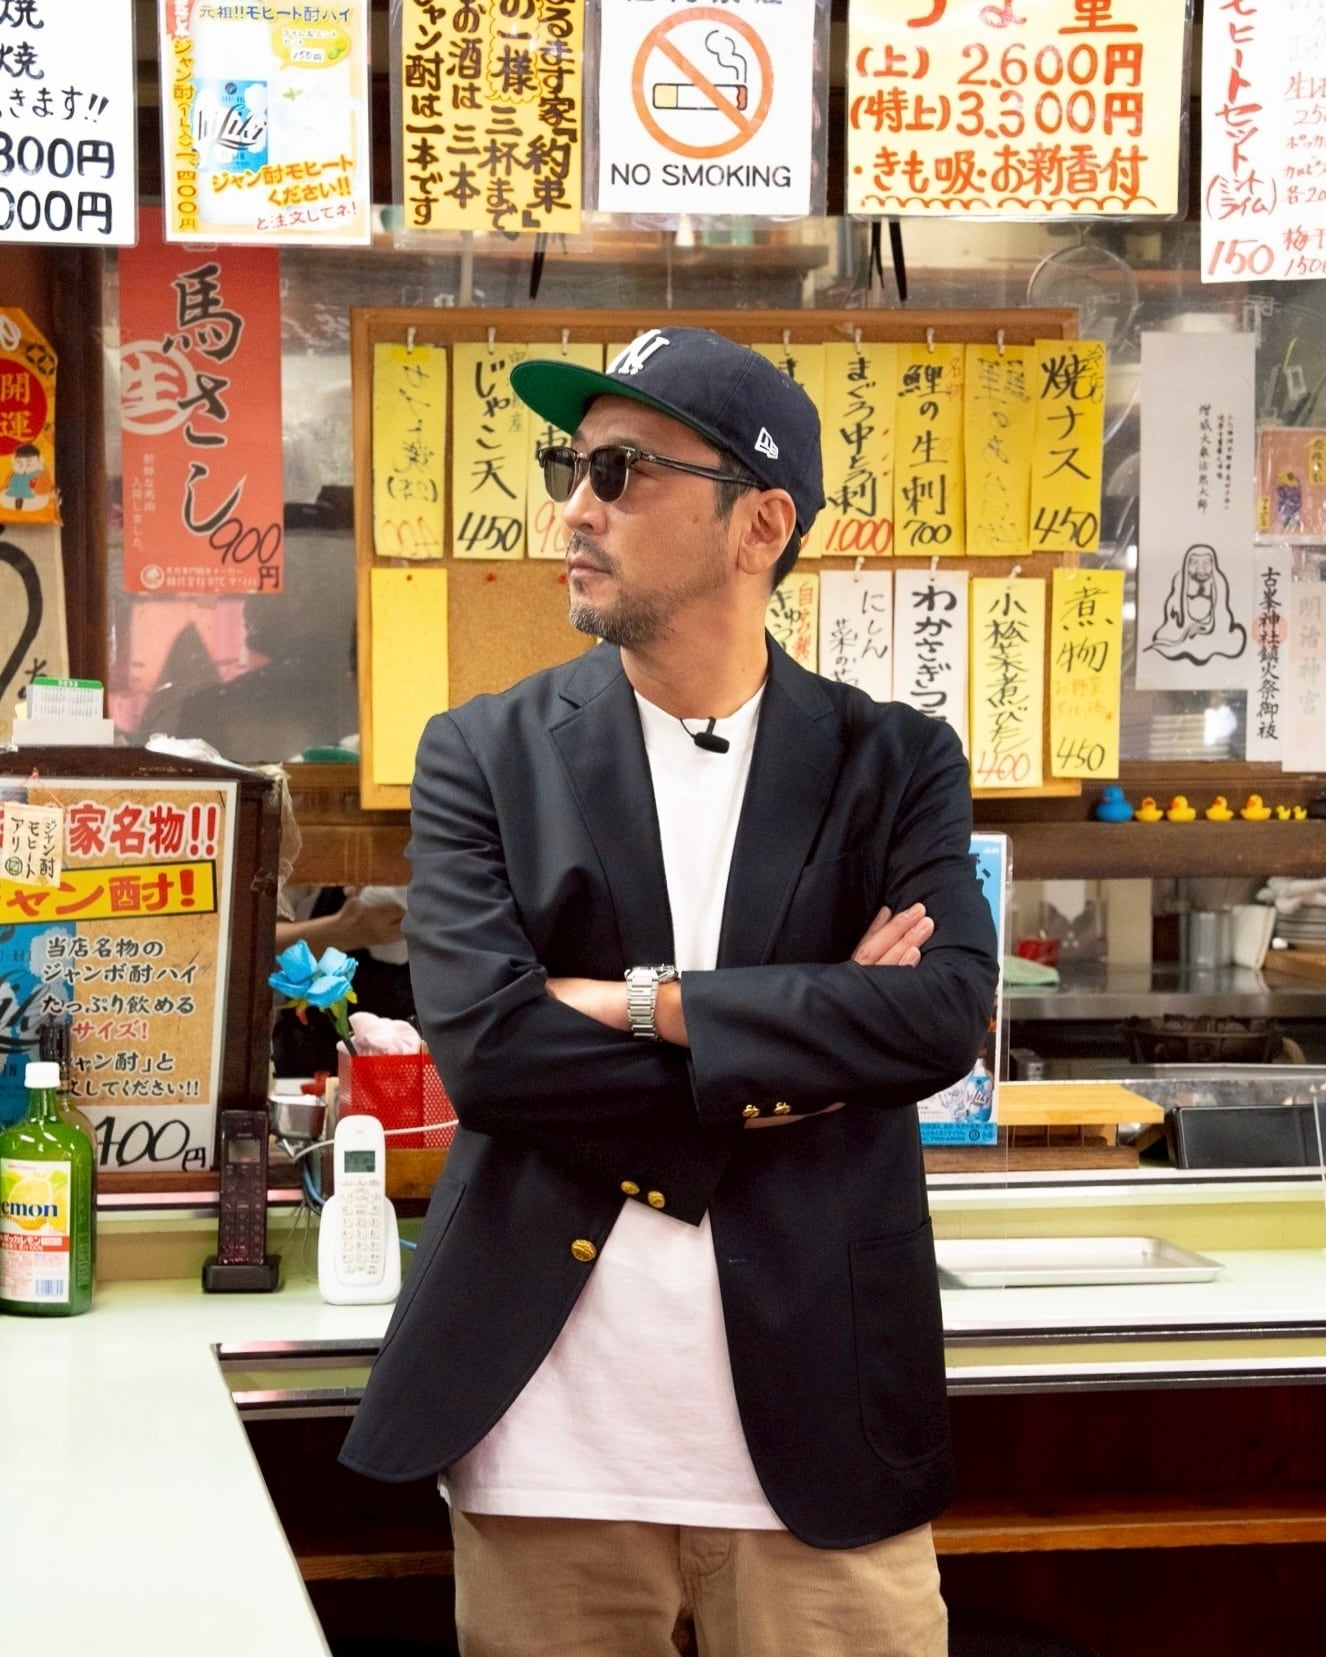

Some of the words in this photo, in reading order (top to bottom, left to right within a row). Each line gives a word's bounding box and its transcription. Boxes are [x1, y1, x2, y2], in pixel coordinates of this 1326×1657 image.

[200, 5, 350, 22] 元祖!!モヒート酎ハイ
[856, 44, 929, 79] (上)
[404, 0, 447, 225] ャン酎は一本です
[850, 87, 951, 133] (特上)
[212, 155, 353, 192] ジャン酎モヒート
[268, 176, 351, 206] ください!!
[611, 163, 649, 186] NO
[662, 163, 791, 188] SMOKING
[1207, 239, 1275, 275] 150
[162, 263, 247, 536] 馬さし
[1040, 354, 1097, 480] 焼ナス
[470, 360, 518, 500] じゃこ天
[209, 518, 281, 564] 900
[457, 512, 523, 551] 450
[903, 519, 952, 546] 700
[1034, 507, 1098, 548] 450
[258, 566, 280, 590] 円
[861, 590, 888, 659] にしん
[1056, 586, 1114, 673] 煮物
[983, 592, 1031, 753] 小松菜煮びたし
[976, 751, 1031, 784] 400
[1056, 737, 1106, 773] 450
[26, 820, 41, 879] モヒート
[47, 937, 164, 957] 当店名物の
[43, 962, 197, 984] ジャンボ酎ハイ
[42, 994, 195, 1015] たっぷり飲める
